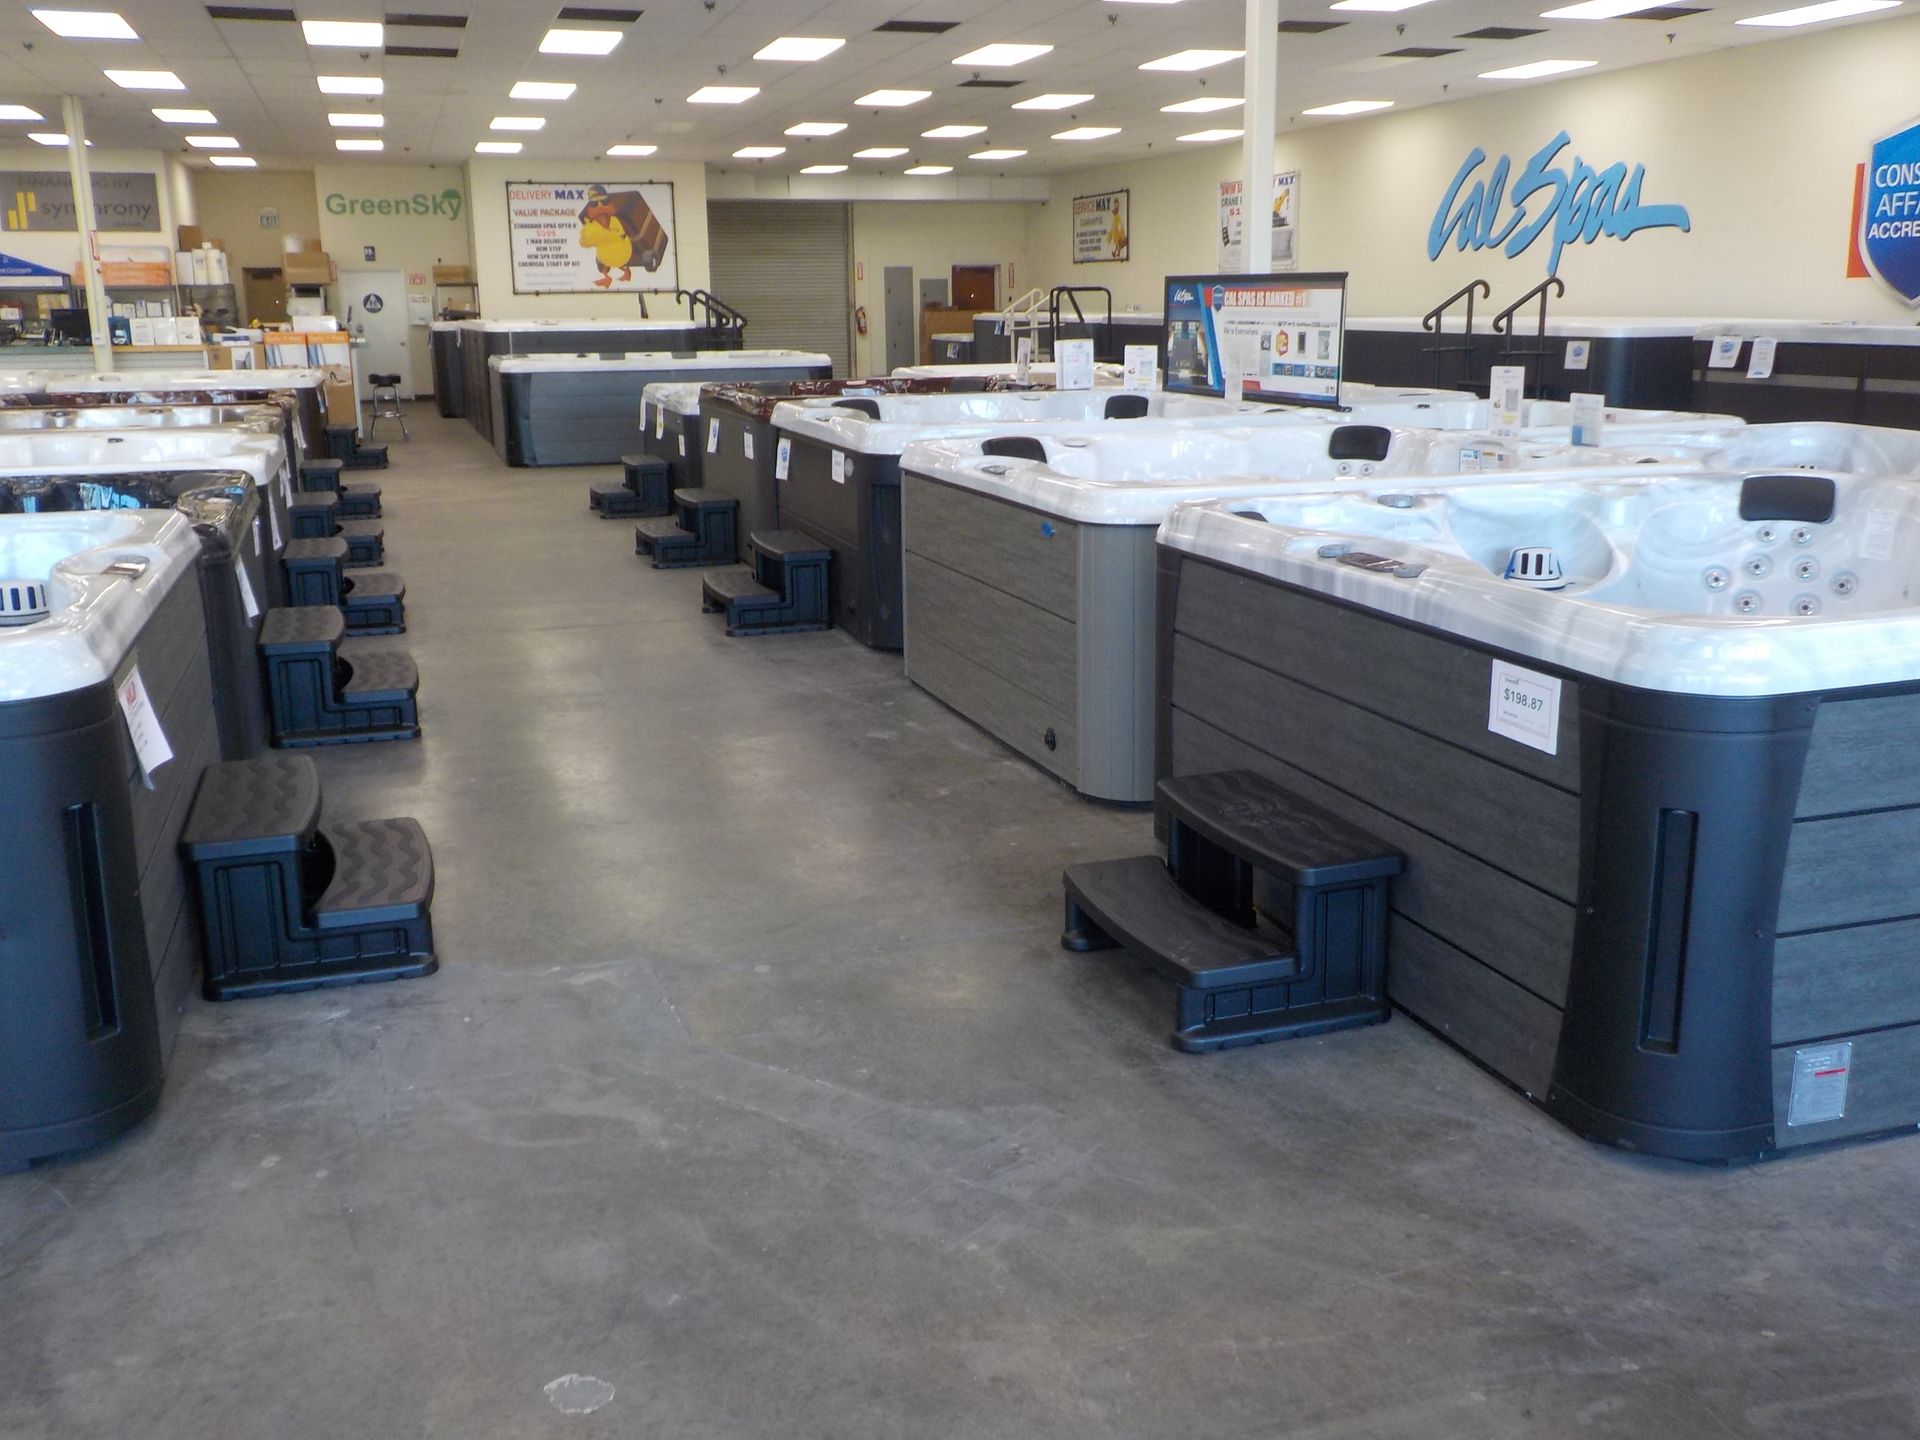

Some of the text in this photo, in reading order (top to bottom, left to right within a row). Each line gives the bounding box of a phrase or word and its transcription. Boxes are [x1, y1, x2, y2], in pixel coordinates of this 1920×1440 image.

[508, 189, 584, 200] DELIVERY MAX
[1428, 130, 1690, 277] Cal Spas
[325, 192, 462, 221] GreenSky
[513, 208, 576, 217] VALUE PACKAGE
[1225, 291, 1237, 306] CAL
[1238, 291, 1257, 306] SPAS
[1257, 291, 1265, 306] IS
[1265, 291, 1295, 306] RANKED
[1504, 688, 1543, 712] $198.87
